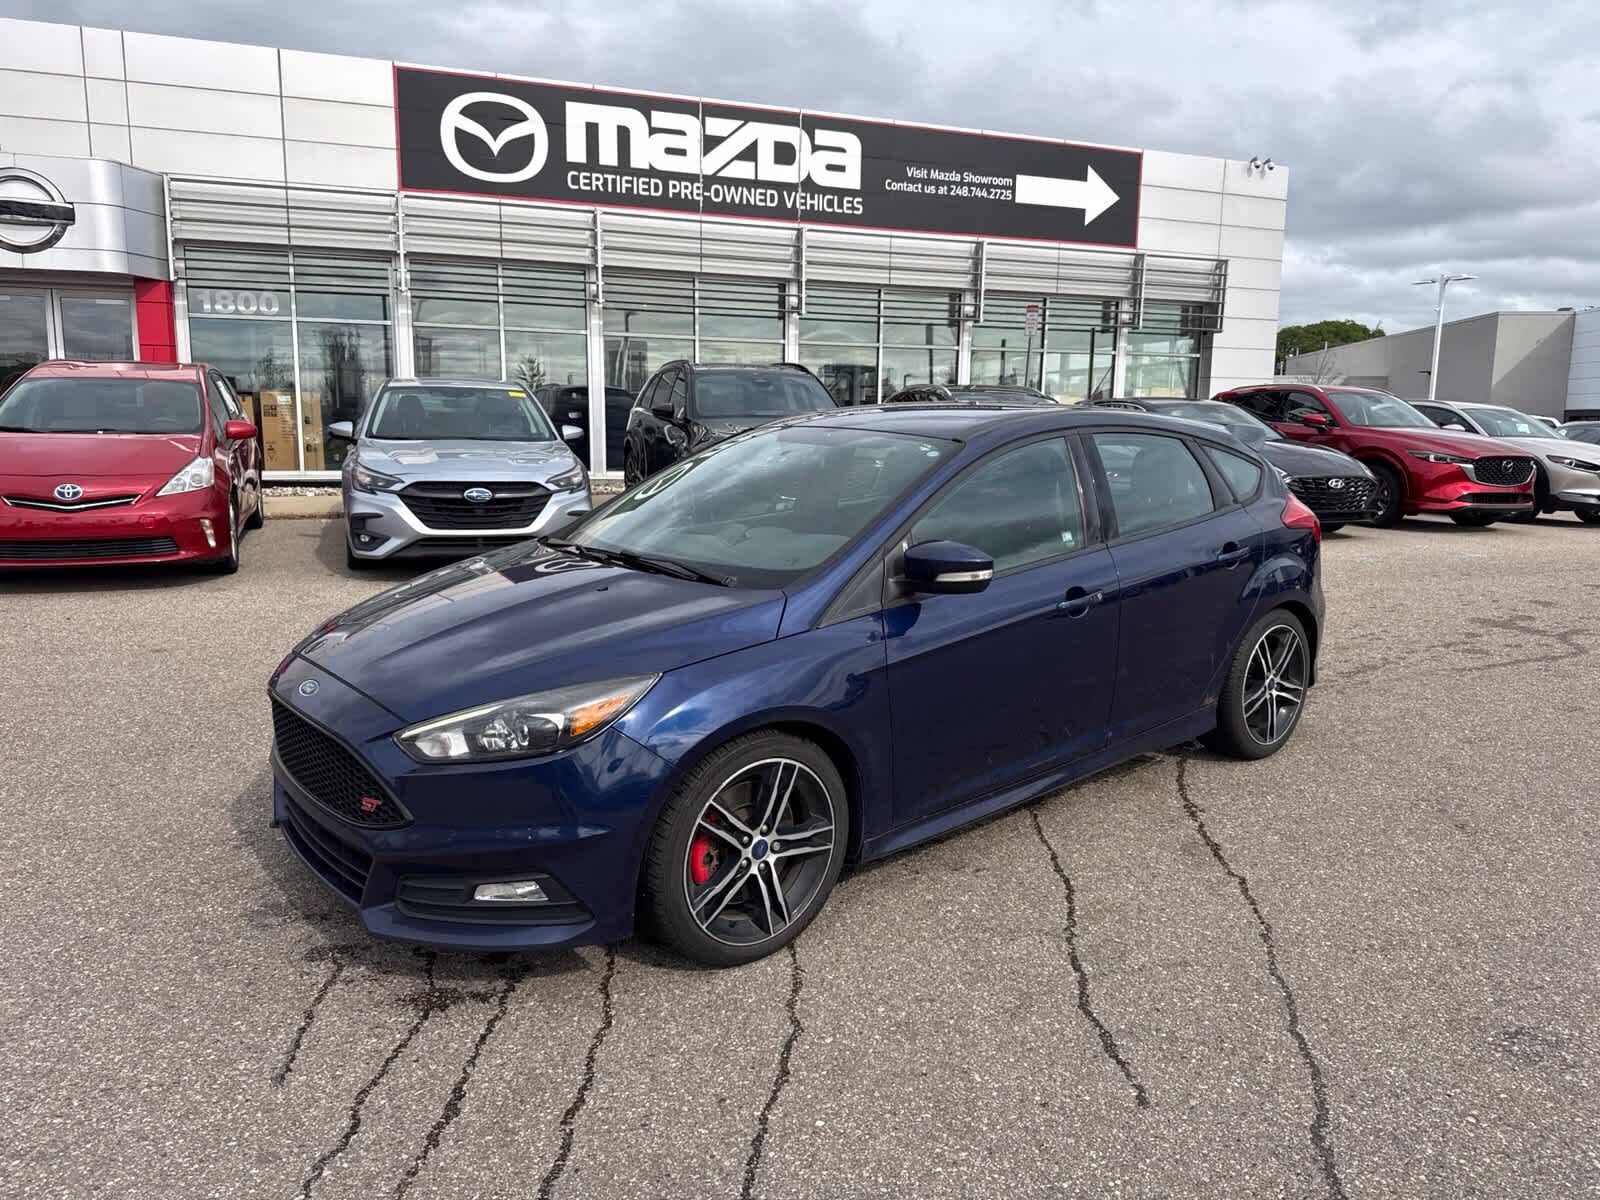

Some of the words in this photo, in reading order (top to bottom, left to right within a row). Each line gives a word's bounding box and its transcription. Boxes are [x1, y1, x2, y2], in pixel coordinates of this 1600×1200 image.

[906, 166, 928, 179] Visit
[930, 169, 961, 183] Mazda
[963, 171, 1013, 187] Showroom
[567, 171, 663, 197] CERTIFIED
[668, 180, 778, 207] PRE-OWNED
[784, 190, 864, 215] VEHICLES
[885, 179, 922, 194] Contact
[924, 184, 936, 195] us
[937, 184, 948, 196] at
[950, 186, 1013, 201] 248.744.2725
[197, 289, 279, 315] 1800
